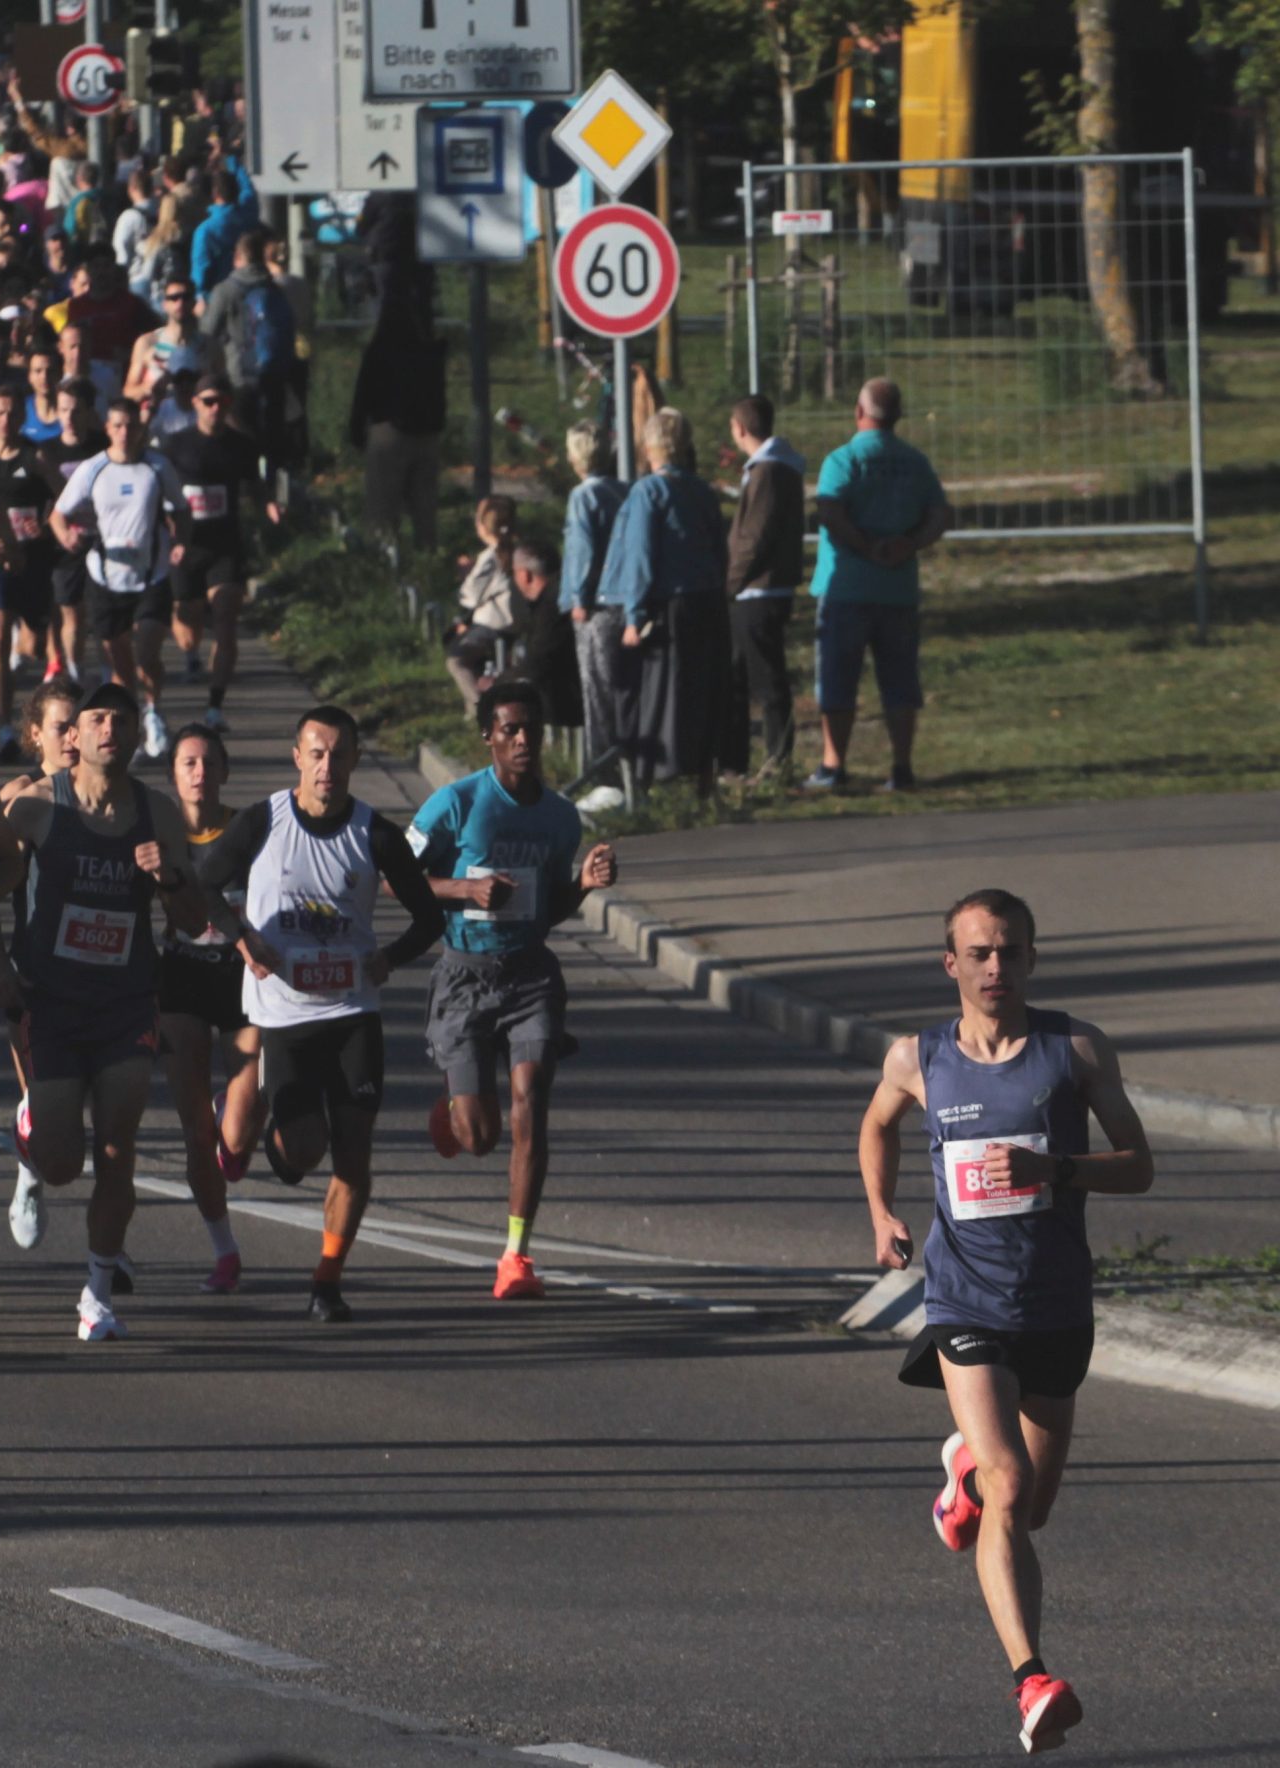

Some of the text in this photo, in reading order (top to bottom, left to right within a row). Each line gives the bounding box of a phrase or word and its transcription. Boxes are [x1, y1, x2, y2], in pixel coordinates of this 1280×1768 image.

[269, 4, 311, 18] Messe
[384, 45, 434, 66] Bitte
[445, 43, 558, 64] einordnen
[74, 65, 109, 95] 60
[400, 69, 456, 90] nach
[523, 69, 542, 87] m
[586, 241, 649, 298] 60
[75, 855, 135, 882] TEAM
[74, 926, 119, 948] 3602
[302, 965, 346, 985] 8578
